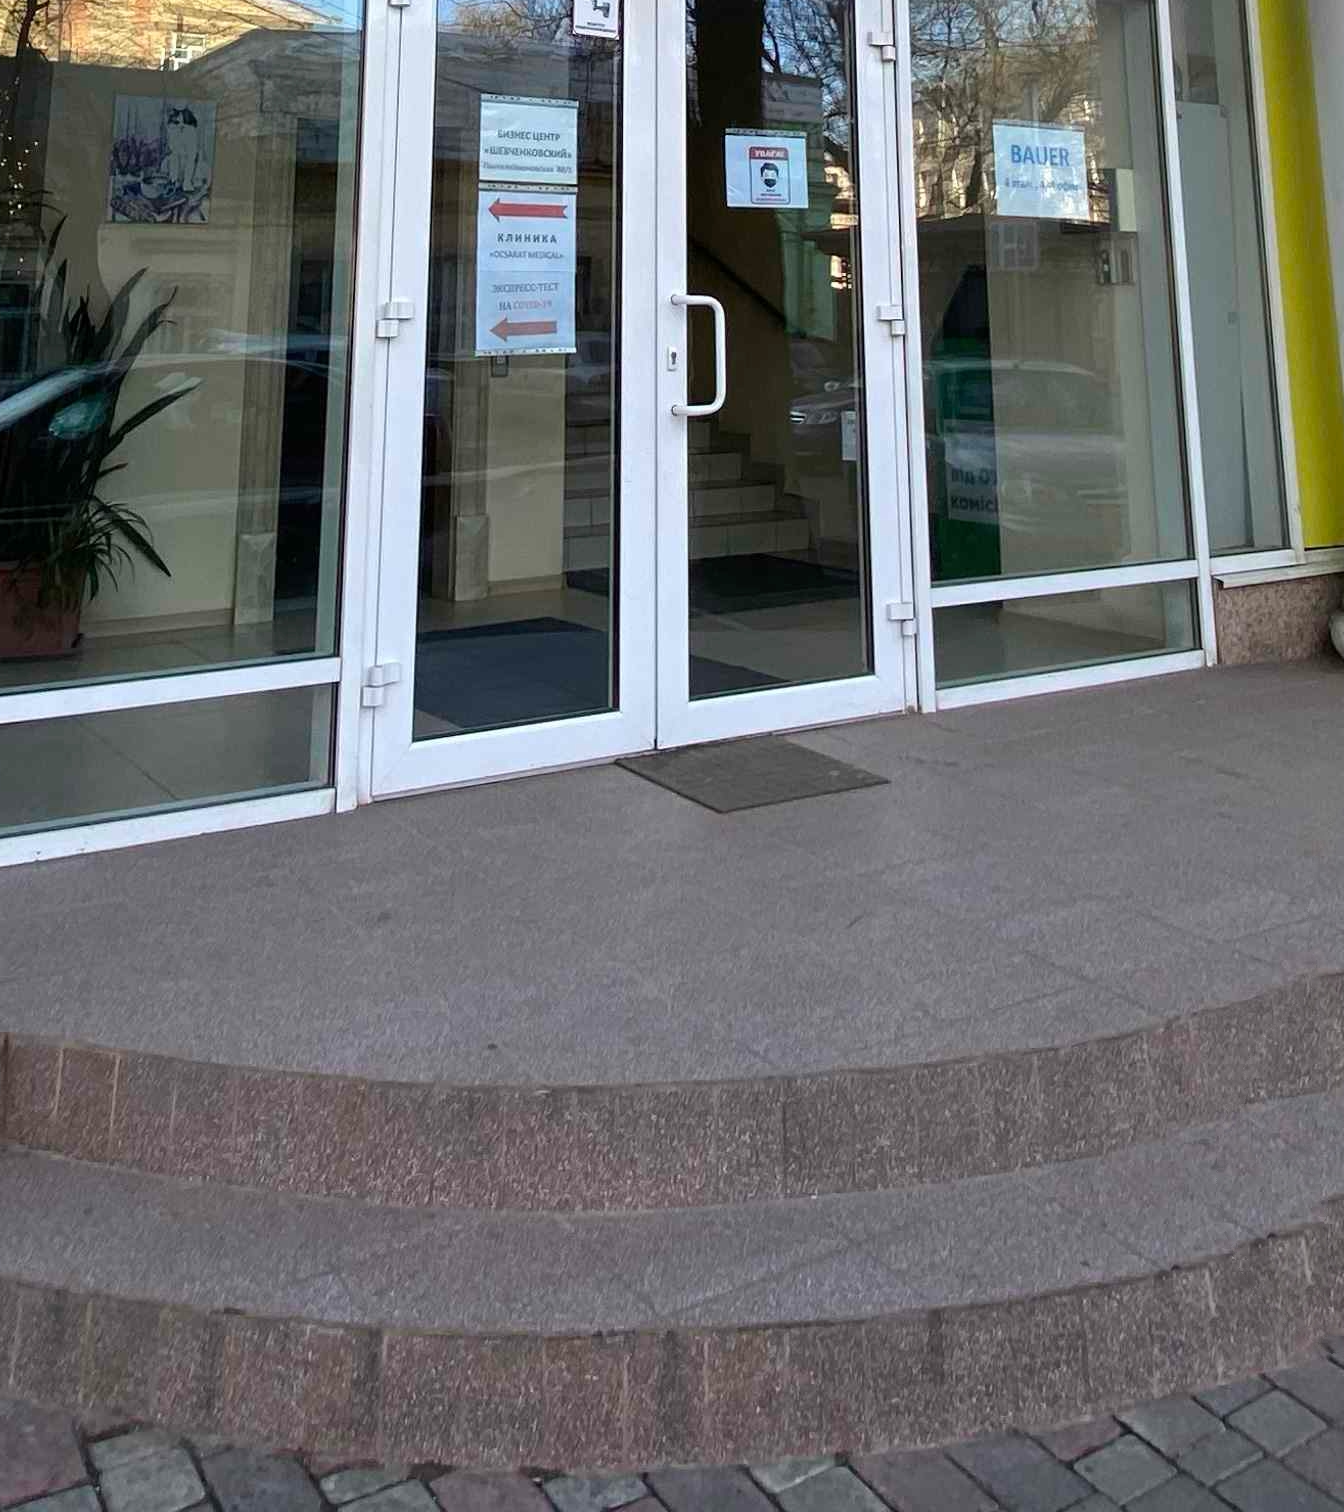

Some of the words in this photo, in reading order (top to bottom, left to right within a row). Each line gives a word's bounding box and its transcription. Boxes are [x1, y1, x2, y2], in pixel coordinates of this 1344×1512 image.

[497, 129, 531, 140] БИЗНЕС
[532, 132, 561, 142] ЦЕНТР
[1010, 144, 1070, 167] BAUER
[497, 232, 557, 244] КЛИНИКА
[499, 301, 512, 311] НА
